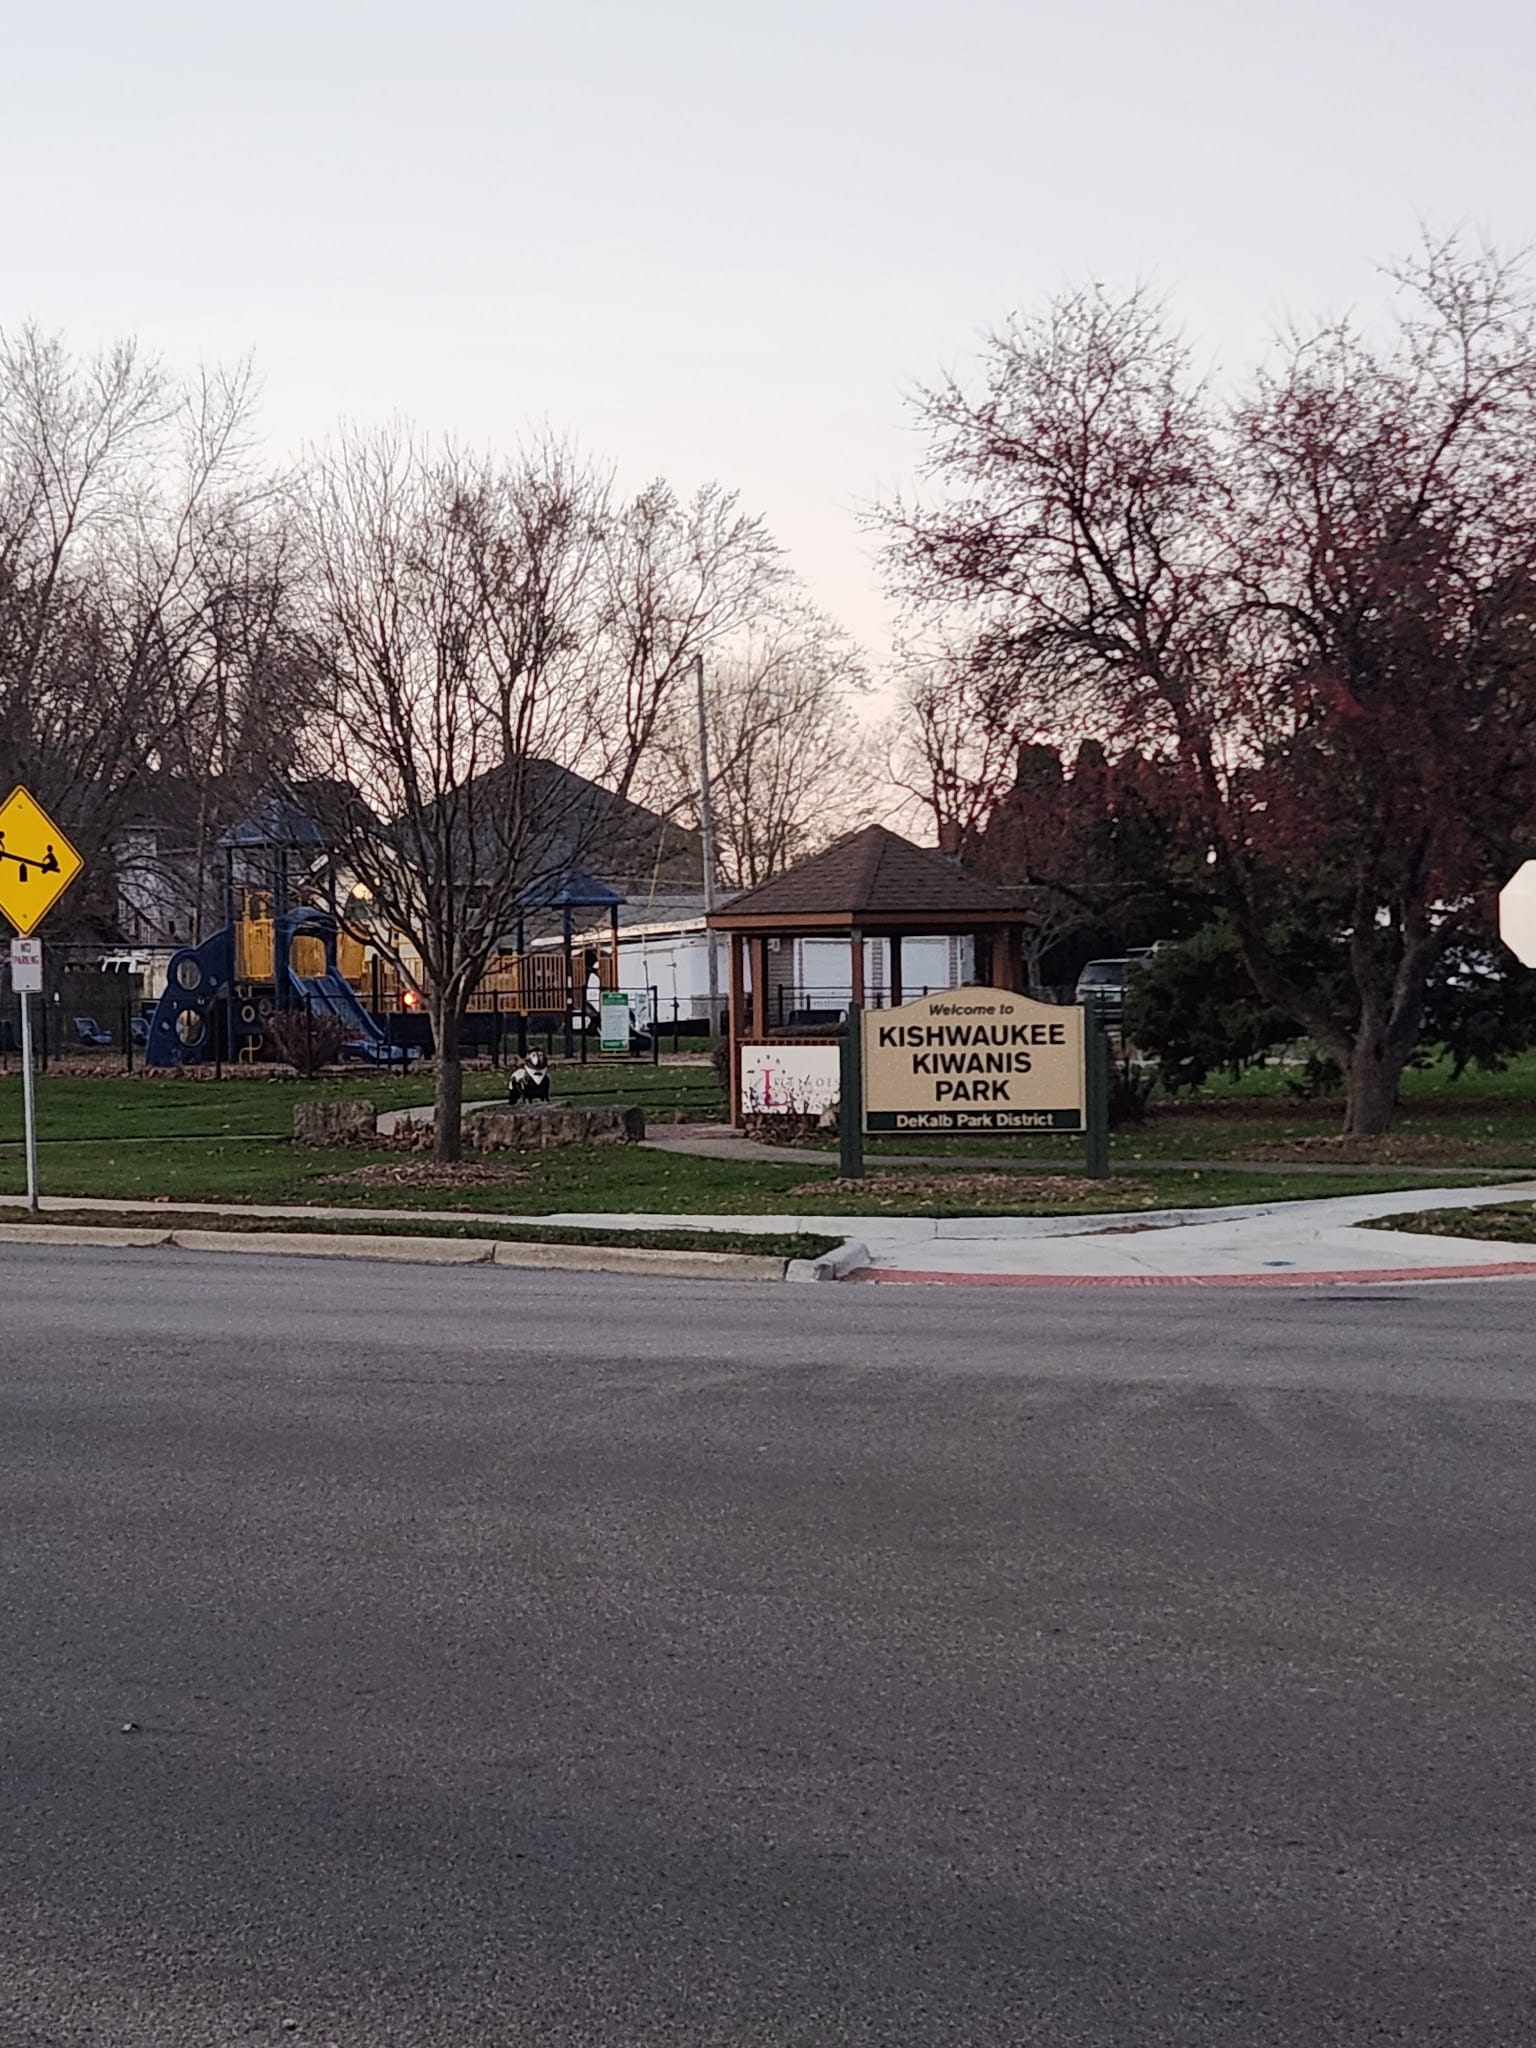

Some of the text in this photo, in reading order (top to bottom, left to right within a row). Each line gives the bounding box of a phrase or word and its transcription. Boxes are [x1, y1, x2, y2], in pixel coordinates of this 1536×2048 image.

[929, 1004, 1014, 1016] Welcome to
[879, 1024, 1066, 1047] KISHWAUKEE
[913, 1052, 1032, 1075] KIWANIS
[935, 1080, 1010, 1101] PARK
[896, 1112, 1054, 1128] DeKalb Park District
